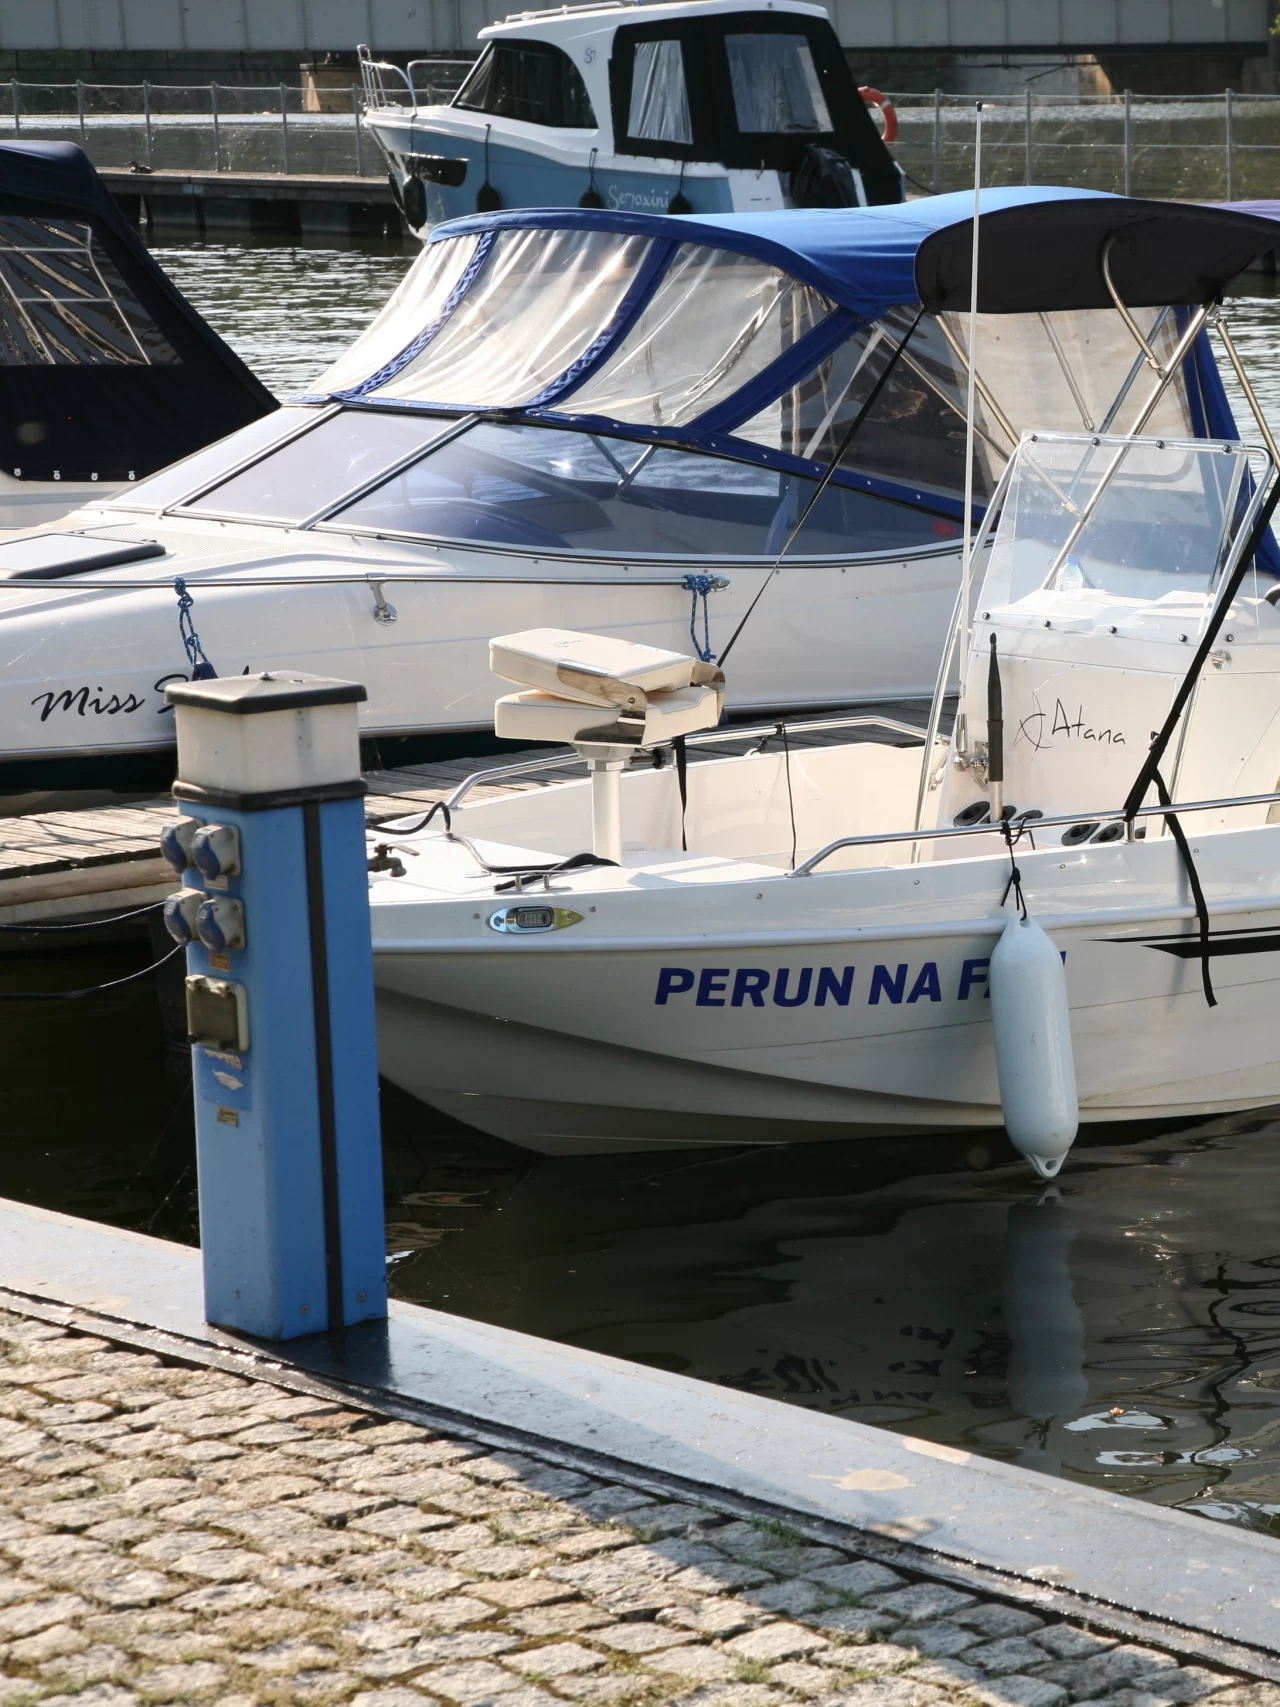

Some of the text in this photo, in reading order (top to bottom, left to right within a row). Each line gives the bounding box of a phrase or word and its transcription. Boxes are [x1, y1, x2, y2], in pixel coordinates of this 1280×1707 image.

[31, 686, 146, 722] Miss
[1051, 698, 1126, 745] Atana
[654, 966, 856, 1008] PERUN
[868, 961, 943, 1006] NA
